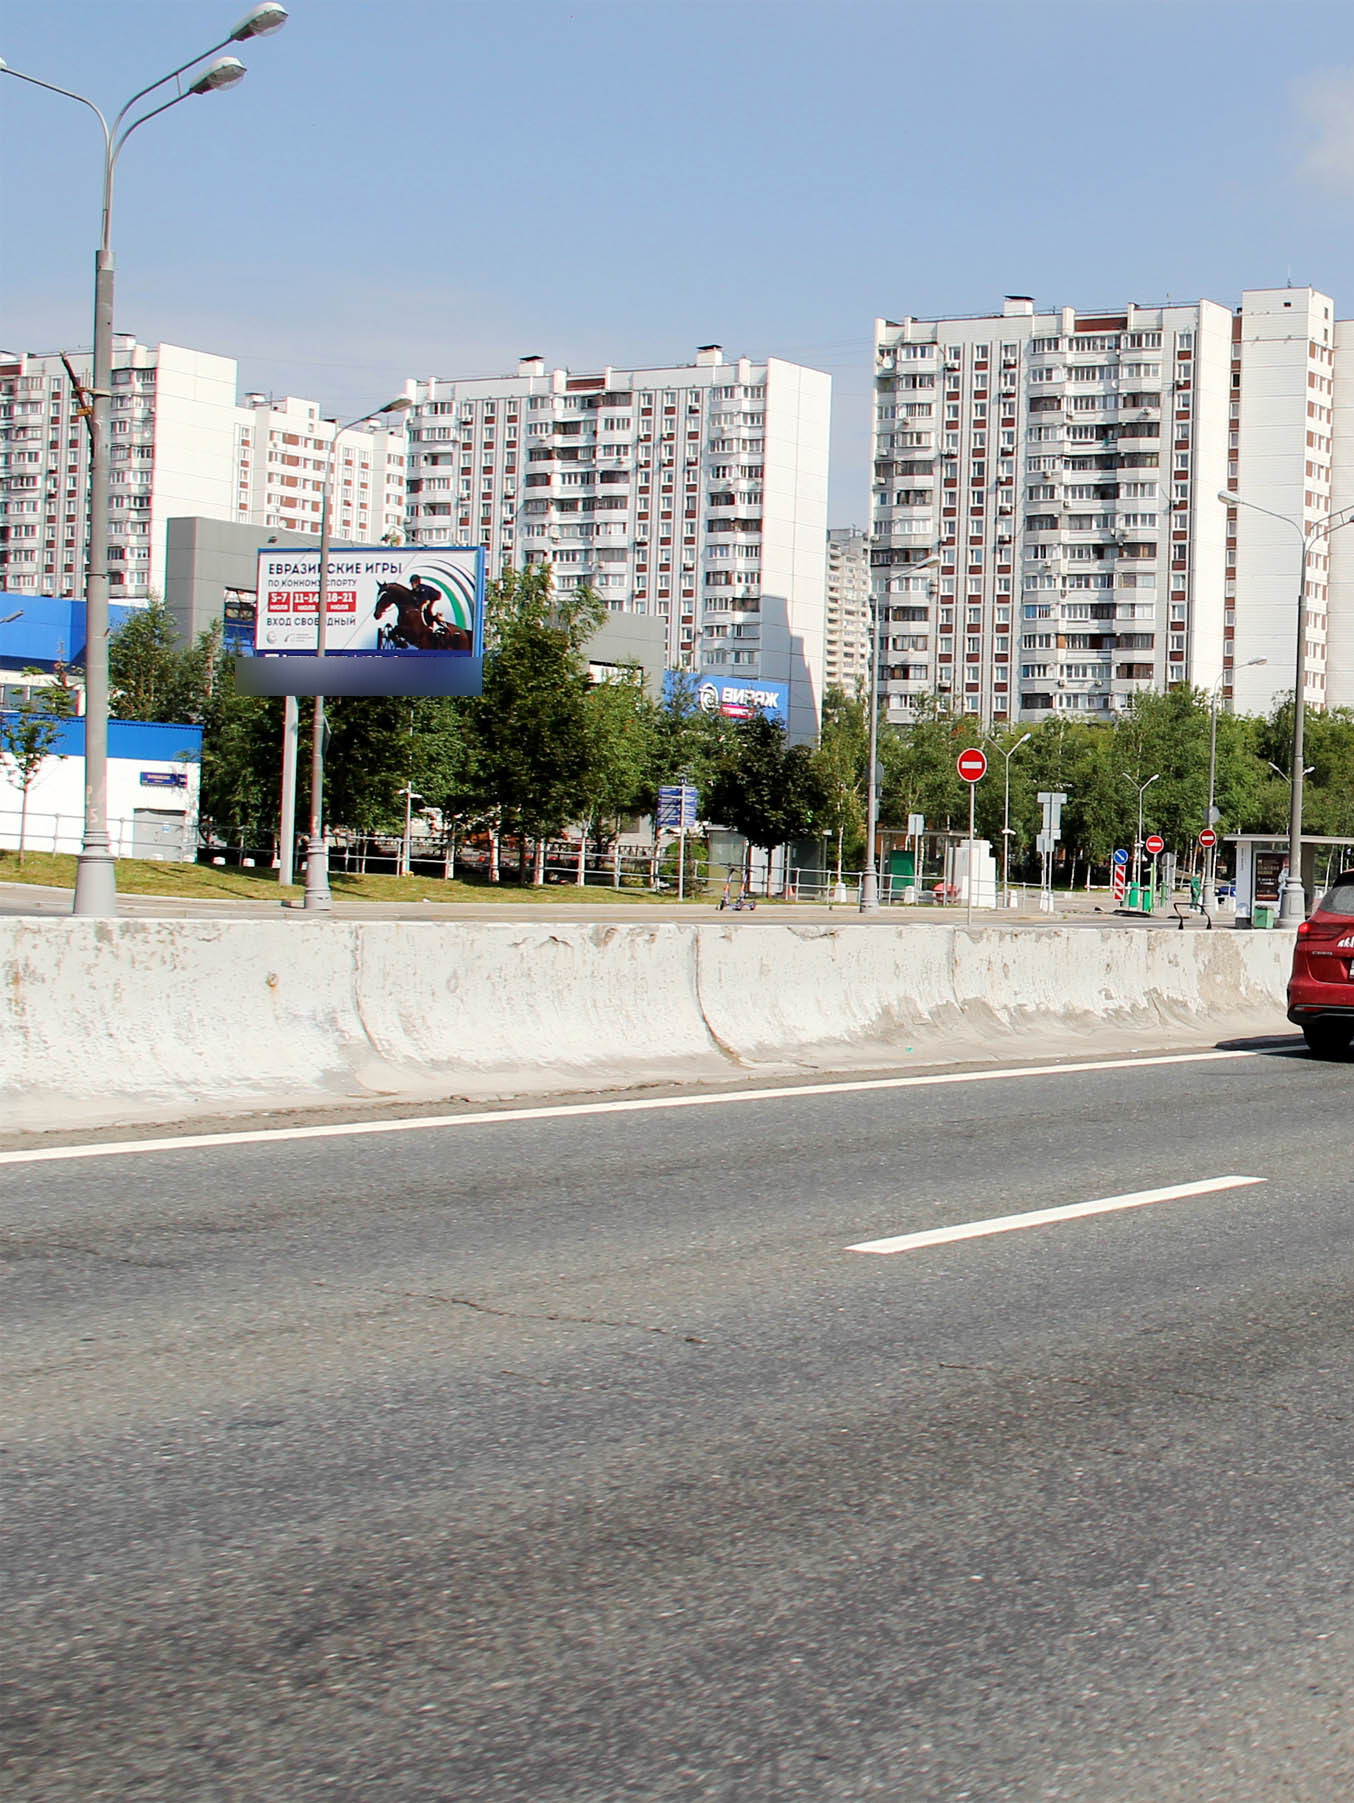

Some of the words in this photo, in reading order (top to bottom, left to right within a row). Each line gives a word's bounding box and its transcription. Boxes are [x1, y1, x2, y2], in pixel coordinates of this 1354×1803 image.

[268, 562, 361, 575] ЕВРАЗИСКИЕ
[365, 562, 402, 574] ИГРЫ
[271, 593, 287, 602] 5-7
[327, 593, 353, 602] 18-21
[266, 617, 292, 626] ВХОД
[294, 615, 356, 626] СВОБДНЫЙ
[721, 687, 780, 708] ВИРАЖ
